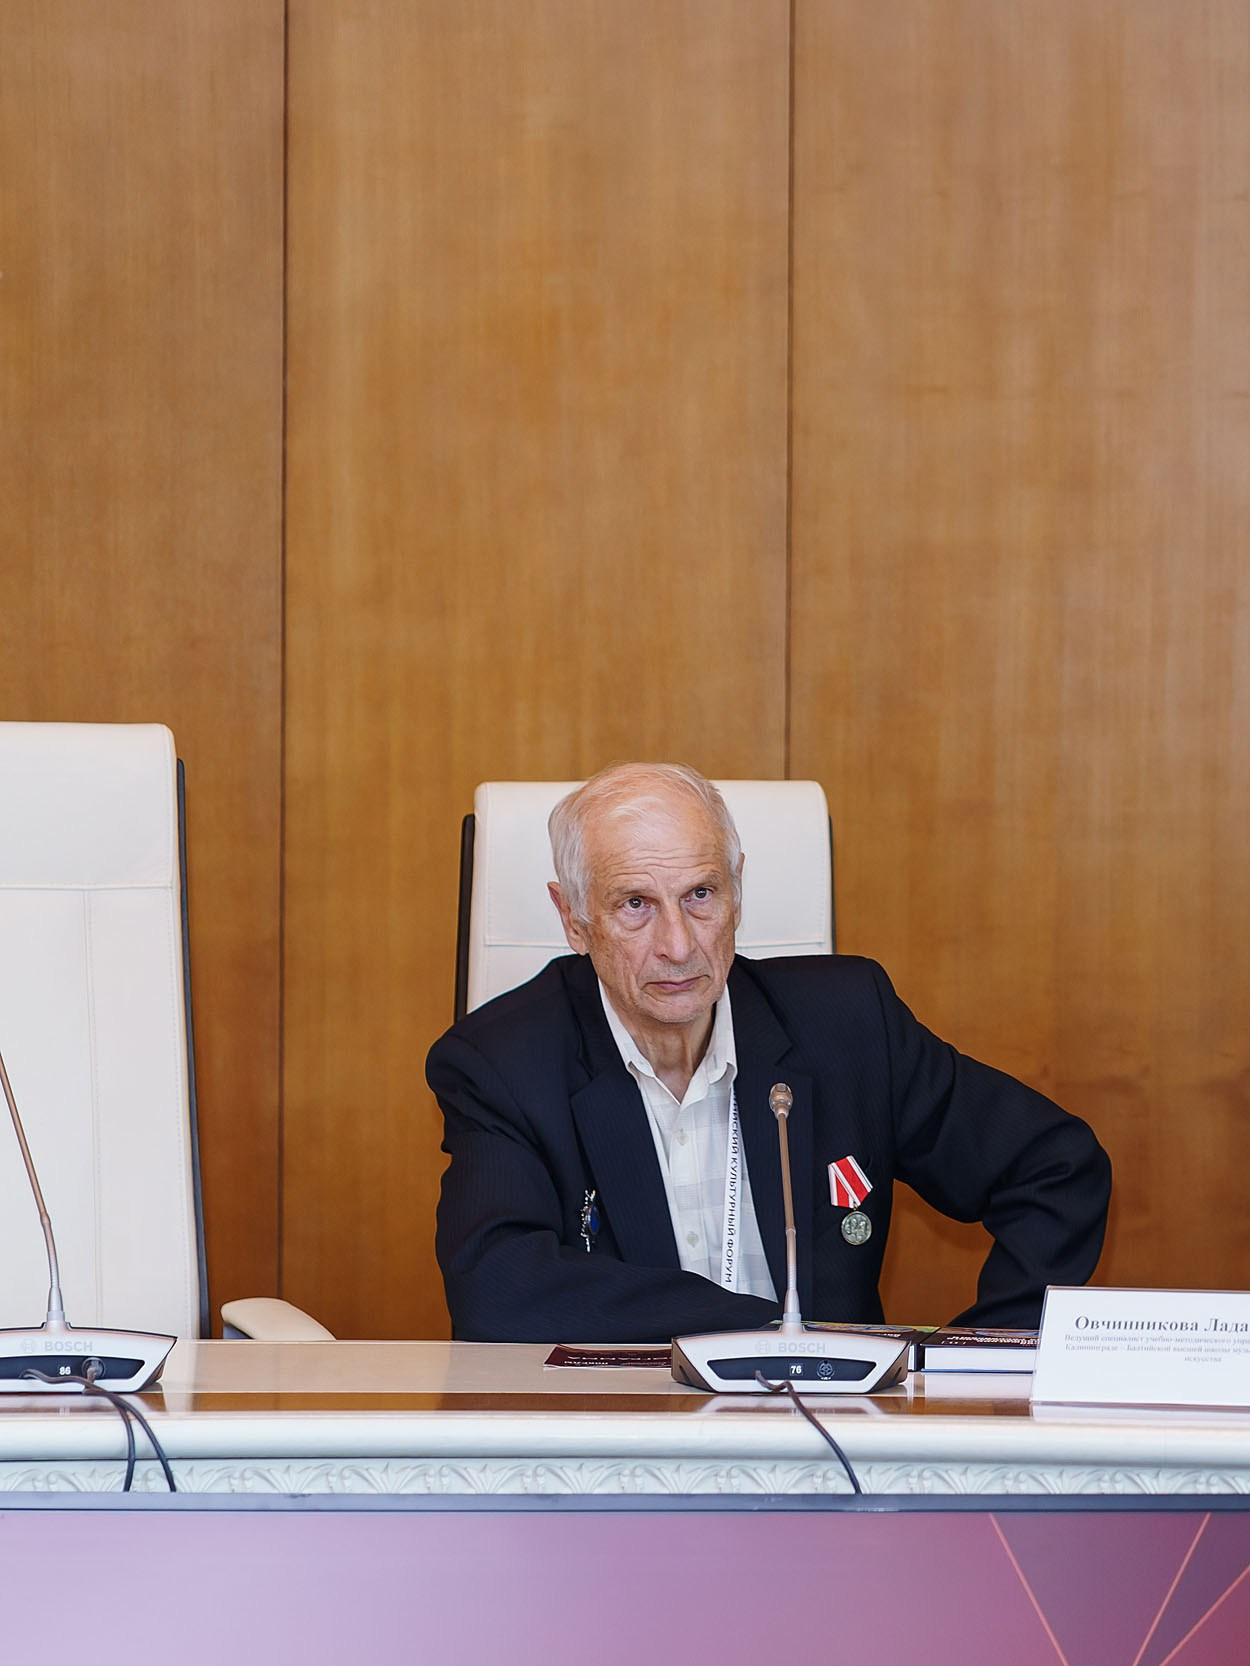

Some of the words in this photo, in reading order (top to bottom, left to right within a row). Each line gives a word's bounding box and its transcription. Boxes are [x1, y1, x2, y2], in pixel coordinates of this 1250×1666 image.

[727, 1157, 738, 1237] КУЛЬТУРНЫЙ
[724, 1238, 735, 1284] ФОРУМ
[1075, 1316, 1199, 1331] Овчинникова
[1203, 1318, 1249, 1333] Лада
[44, 1341, 93, 1352] BOSCH
[778, 1342, 826, 1353] BOSCH
[790, 1365, 801, 1374] 76
